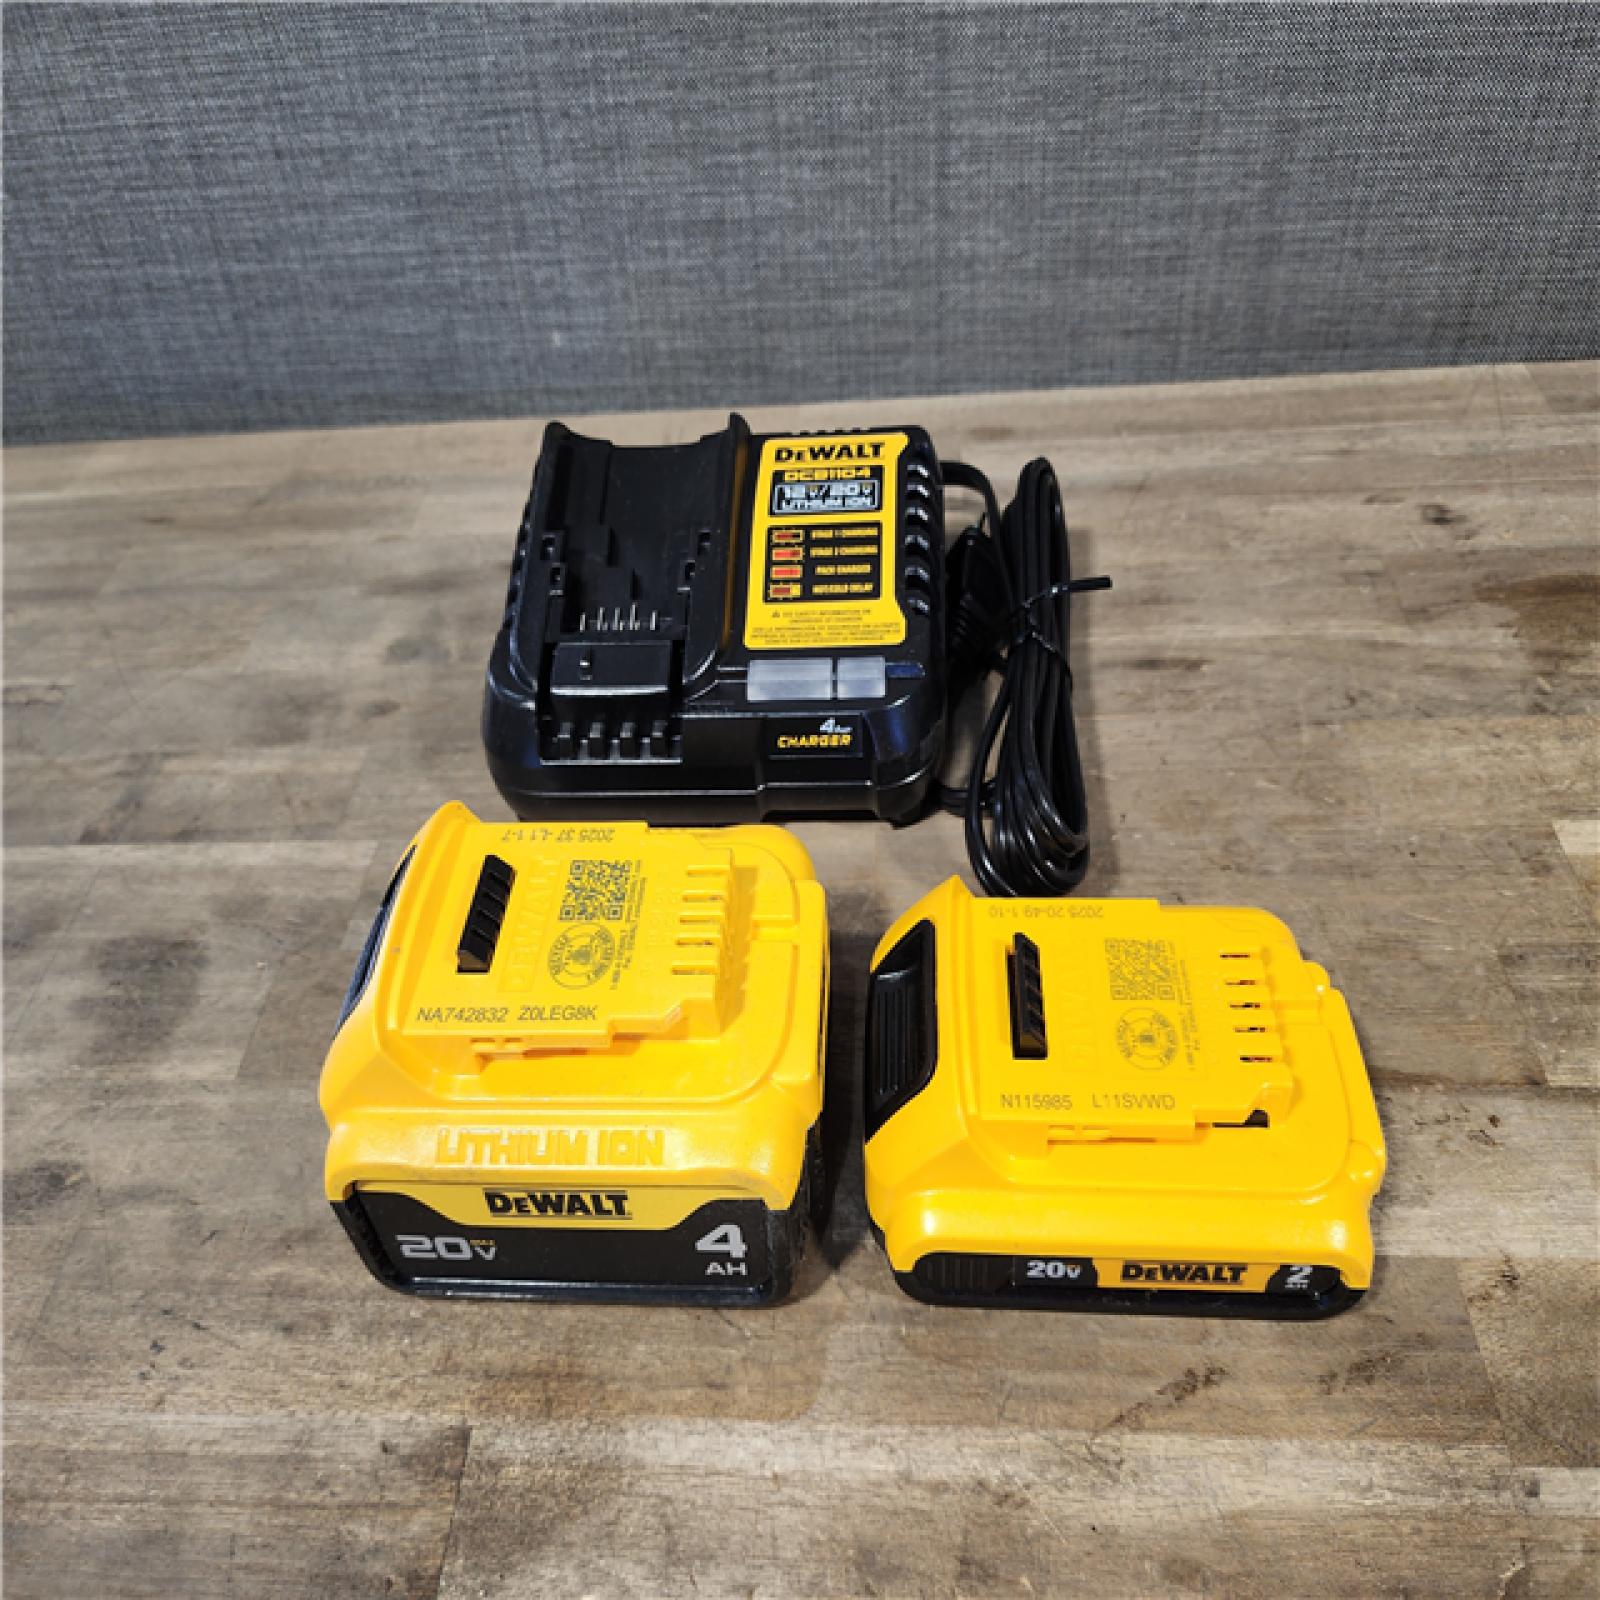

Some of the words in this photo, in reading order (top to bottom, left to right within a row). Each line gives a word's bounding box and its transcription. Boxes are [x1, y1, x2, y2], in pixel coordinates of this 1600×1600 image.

[820, 717, 835, 733] 4
[776, 734, 852, 749] CHARGER
[437, 1128, 588, 1167] LITHIUM
[597, 1127, 665, 1167] ION
[485, 1192, 629, 1216] DEWALT
[694, 1223, 748, 1260] 4
[704, 1262, 748, 1276] AH
[1122, 1263, 1247, 1283] DEWALT
[1287, 1264, 1314, 1283] 2
